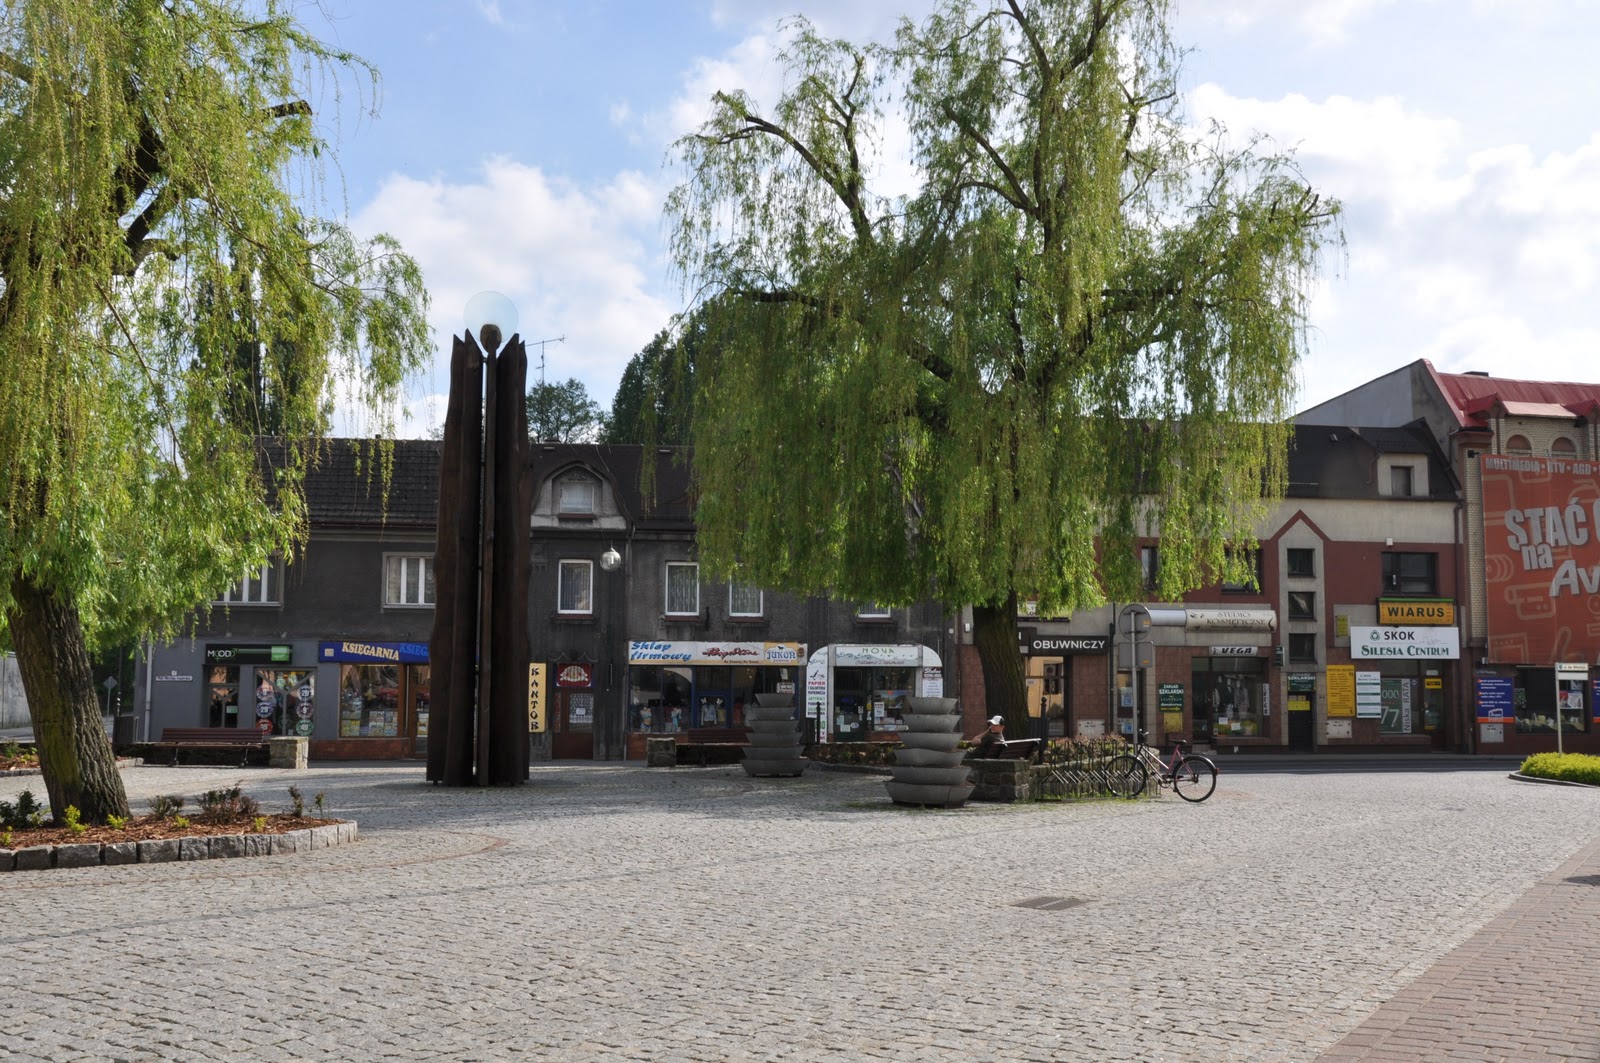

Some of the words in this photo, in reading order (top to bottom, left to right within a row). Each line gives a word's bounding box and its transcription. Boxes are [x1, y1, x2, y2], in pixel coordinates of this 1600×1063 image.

[1485, 457, 1540, 473] MULTIMEDIA
[1573, 463, 1591, 475] AGD
[1504, 497, 1589, 551] STAĆ
[1521, 543, 1553, 570] na
[1387, 607, 1444, 617] WIARUS
[1384, 631, 1415, 640] SKOK
[342, 642, 399, 661] KSIĘGARNIA
[631, 641, 672, 652] Sklep
[1033, 640, 1105, 649] OBUWNICZY
[631, 651, 692, 662] firmowy
[530, 667, 539, 731] KANTOR
